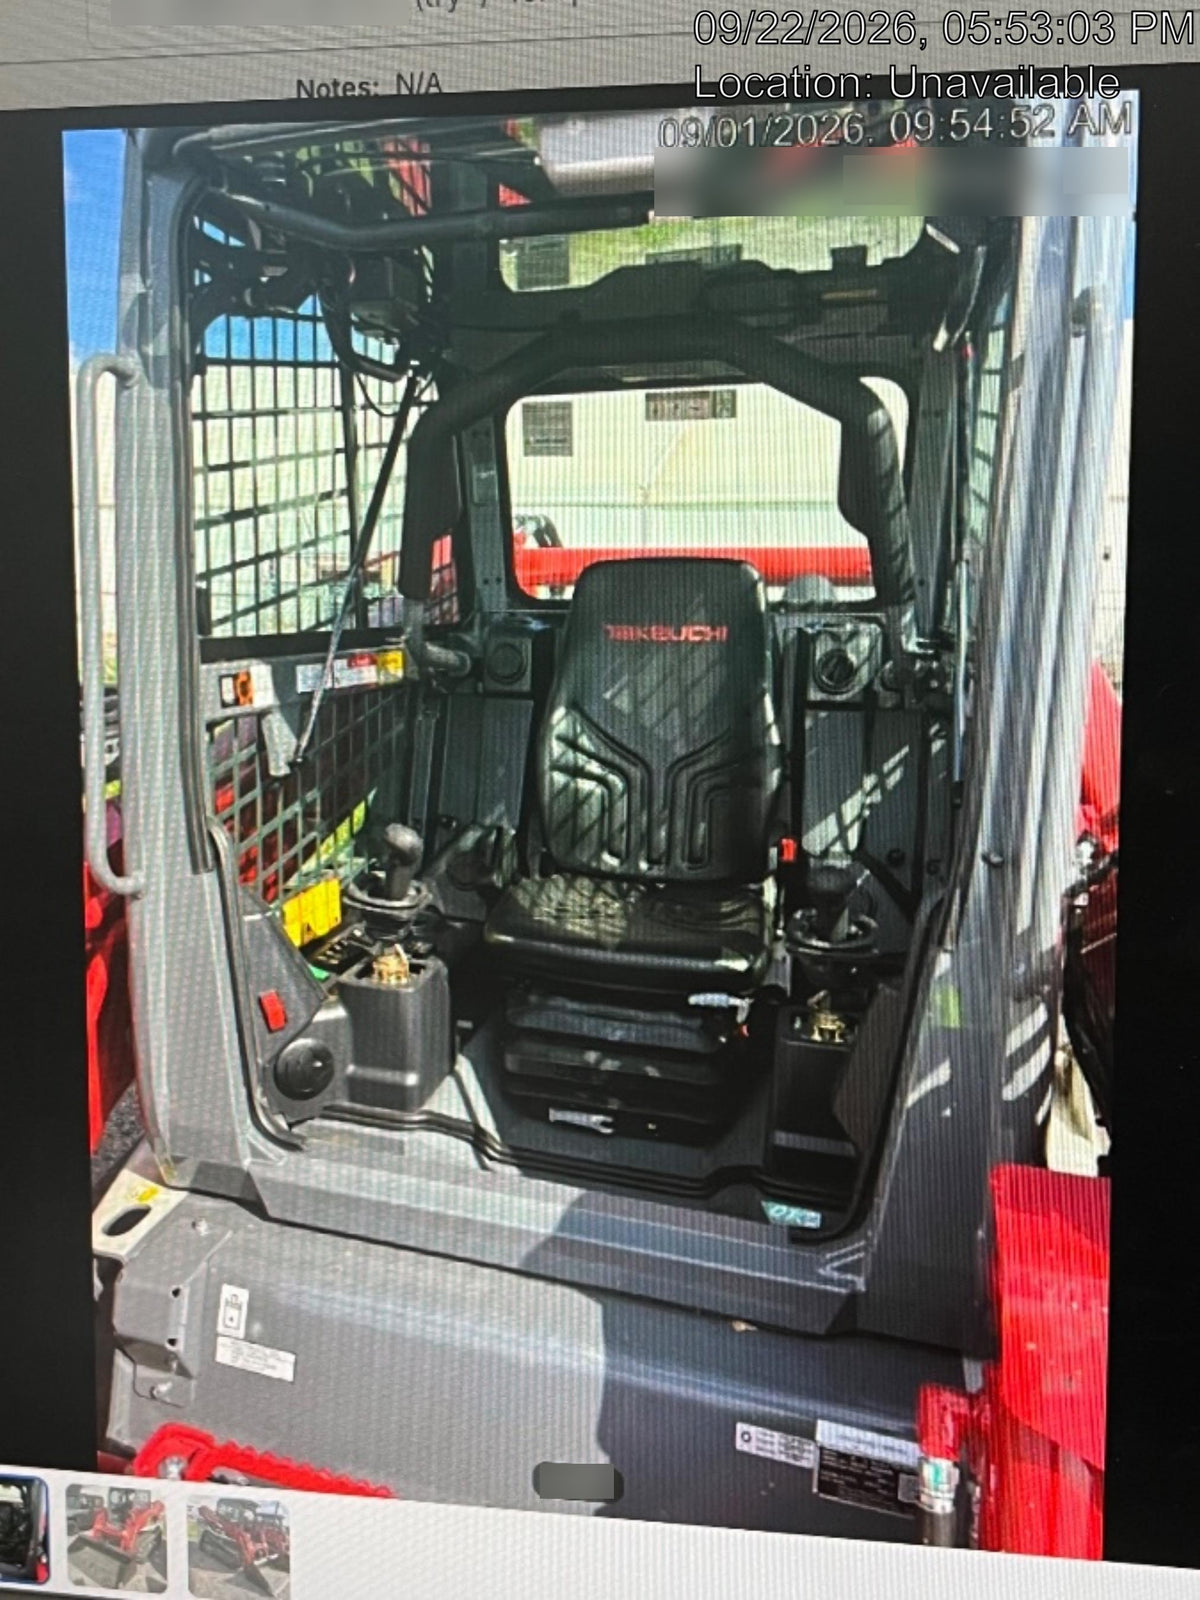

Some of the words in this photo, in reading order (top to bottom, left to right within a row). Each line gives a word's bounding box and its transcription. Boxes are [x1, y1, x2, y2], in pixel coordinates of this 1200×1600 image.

[296, 78, 379, 98] Notes:
[396, 71, 442, 95] N/A
[889, 103, 1056, 143] 09:54:52
[1066, 101, 1132, 136] AM
